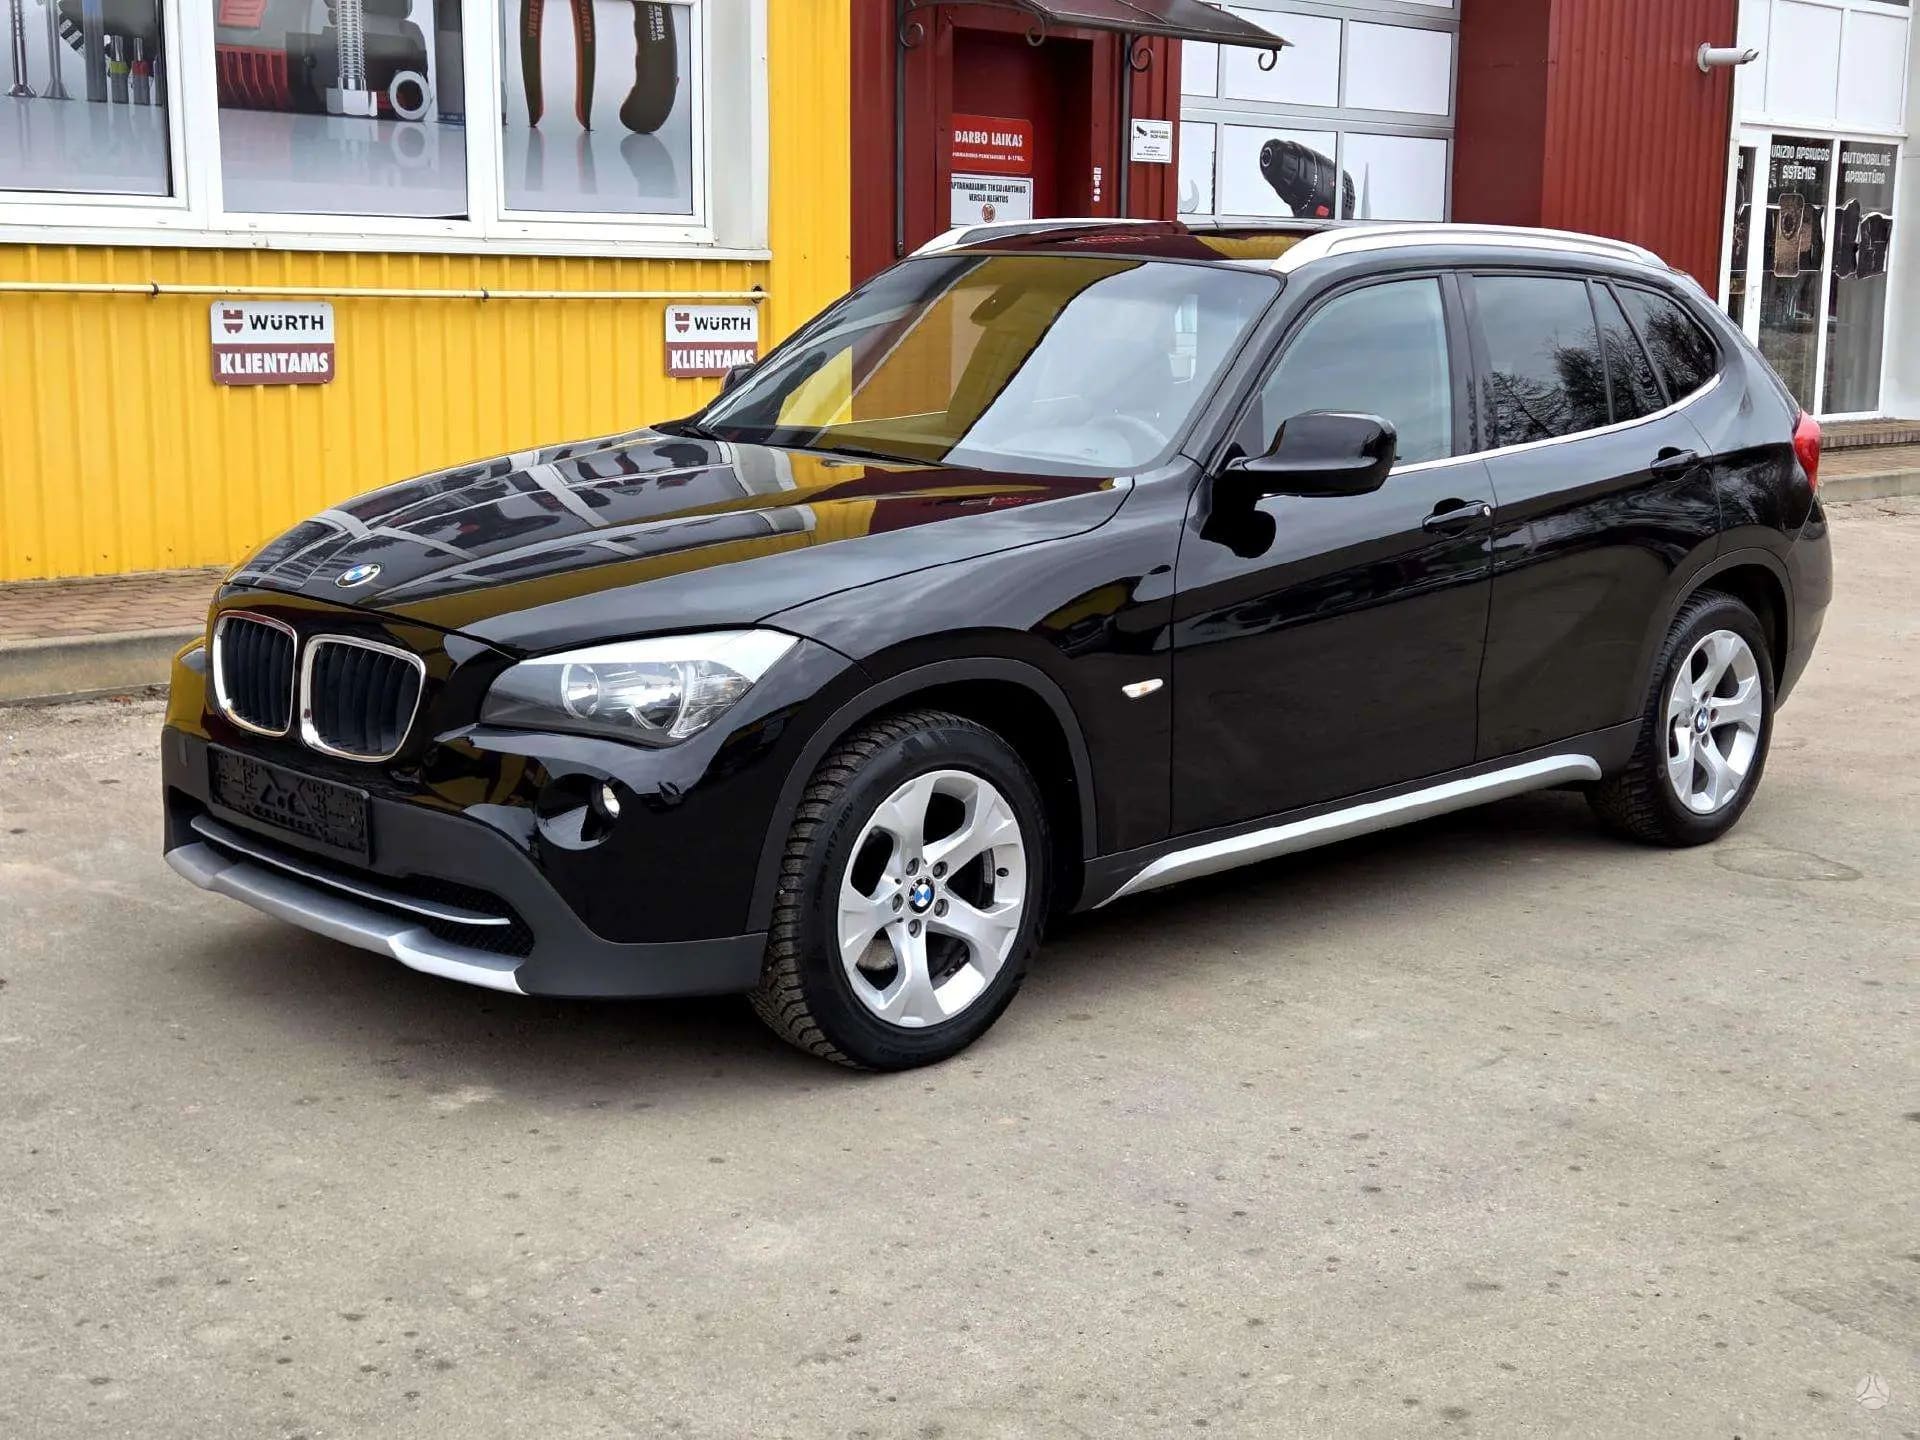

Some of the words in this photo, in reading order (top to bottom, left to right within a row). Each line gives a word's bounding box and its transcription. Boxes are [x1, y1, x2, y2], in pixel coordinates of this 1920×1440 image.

[653, 4, 666, 41] ZEBRA
[954, 130, 988, 145] DARBO
[991, 132, 1023, 147] LAIKAS
[1782, 165, 1816, 180] SISTEMOS
[249, 314, 324, 331] WÜRTH
[694, 316, 751, 331] WÜRTH
[220, 352, 329, 374] KLIENTAMS
[672, 349, 754, 368] KLIENTAMS
